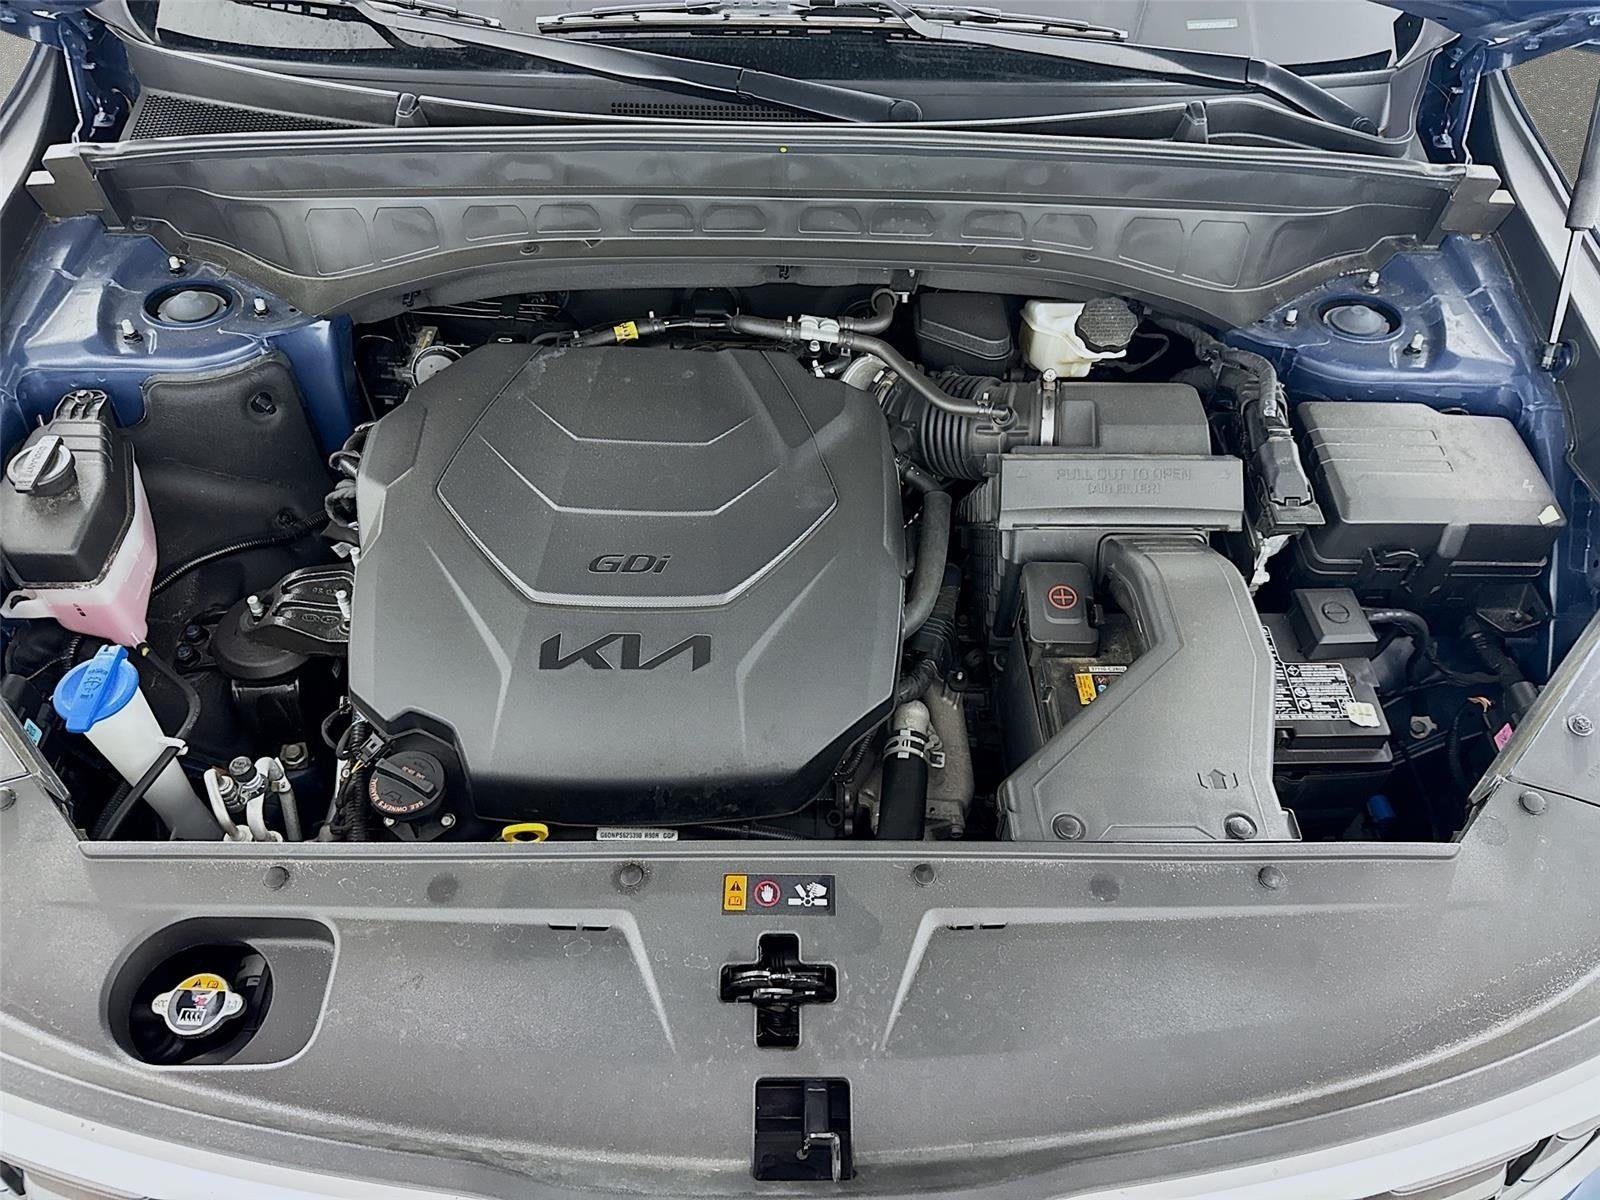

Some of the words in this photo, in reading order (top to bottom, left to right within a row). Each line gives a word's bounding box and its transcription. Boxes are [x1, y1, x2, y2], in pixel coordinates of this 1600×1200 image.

[1056, 468, 1092, 481] PULL
[1097, 468, 1126, 481] OUT
[1130, 468, 1149, 481] TO
[1151, 468, 1191, 481] OPEN
[587, 553, 673, 575] GDi
[539, 632, 711, 672] KIA
[378, 802, 408, 812] OWNER'S
[410, 800, 424, 810] SEE
